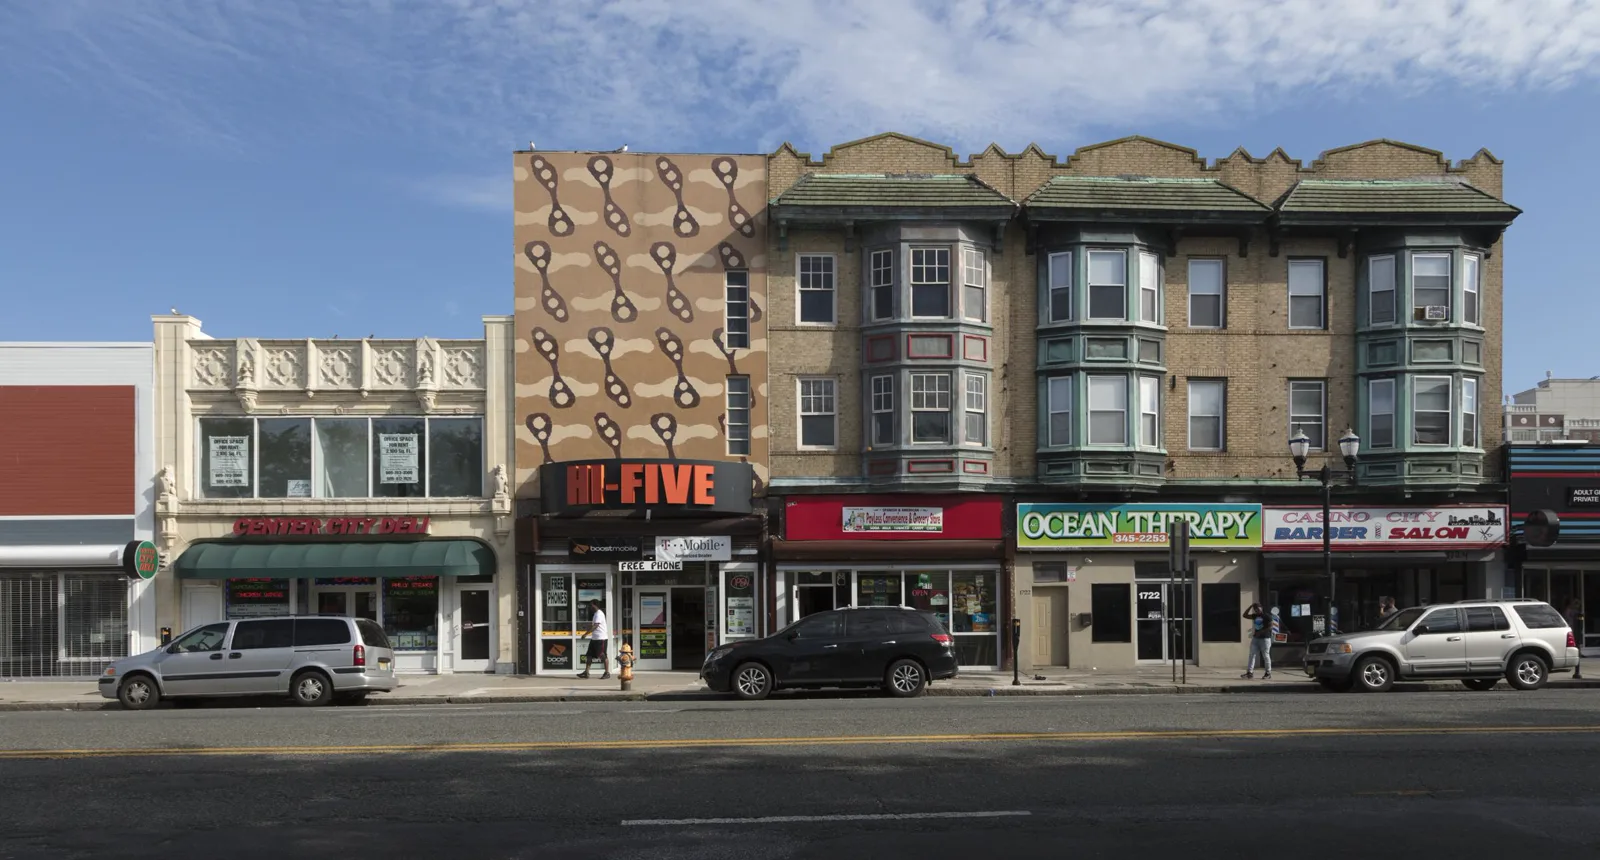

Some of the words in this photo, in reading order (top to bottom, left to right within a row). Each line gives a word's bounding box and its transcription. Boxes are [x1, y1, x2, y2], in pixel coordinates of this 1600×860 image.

[567, 464, 715, 504] HI-FIVE
[883, 513, 908, 524] Convenience
[913, 513, 930, 526] Grocery
[930, 513, 940, 524] Store
[1282, 512, 1370, 522] CASINO
[1386, 512, 1442, 522] CITY
[233, 518, 322, 535] CENTER
[325, 518, 376, 535] CITY
[379, 516, 430, 535] DELI
[1022, 511, 1121, 539] OCEAN
[1116, 534, 1166, 542] 345-2253
[1274, 527, 1368, 539] BARBER
[1388, 527, 1470, 539] SALON
[651, 561, 681, 570] PHONE
[552, 578, 563, 589] FREE
[548, 590, 567, 604] PHONES
